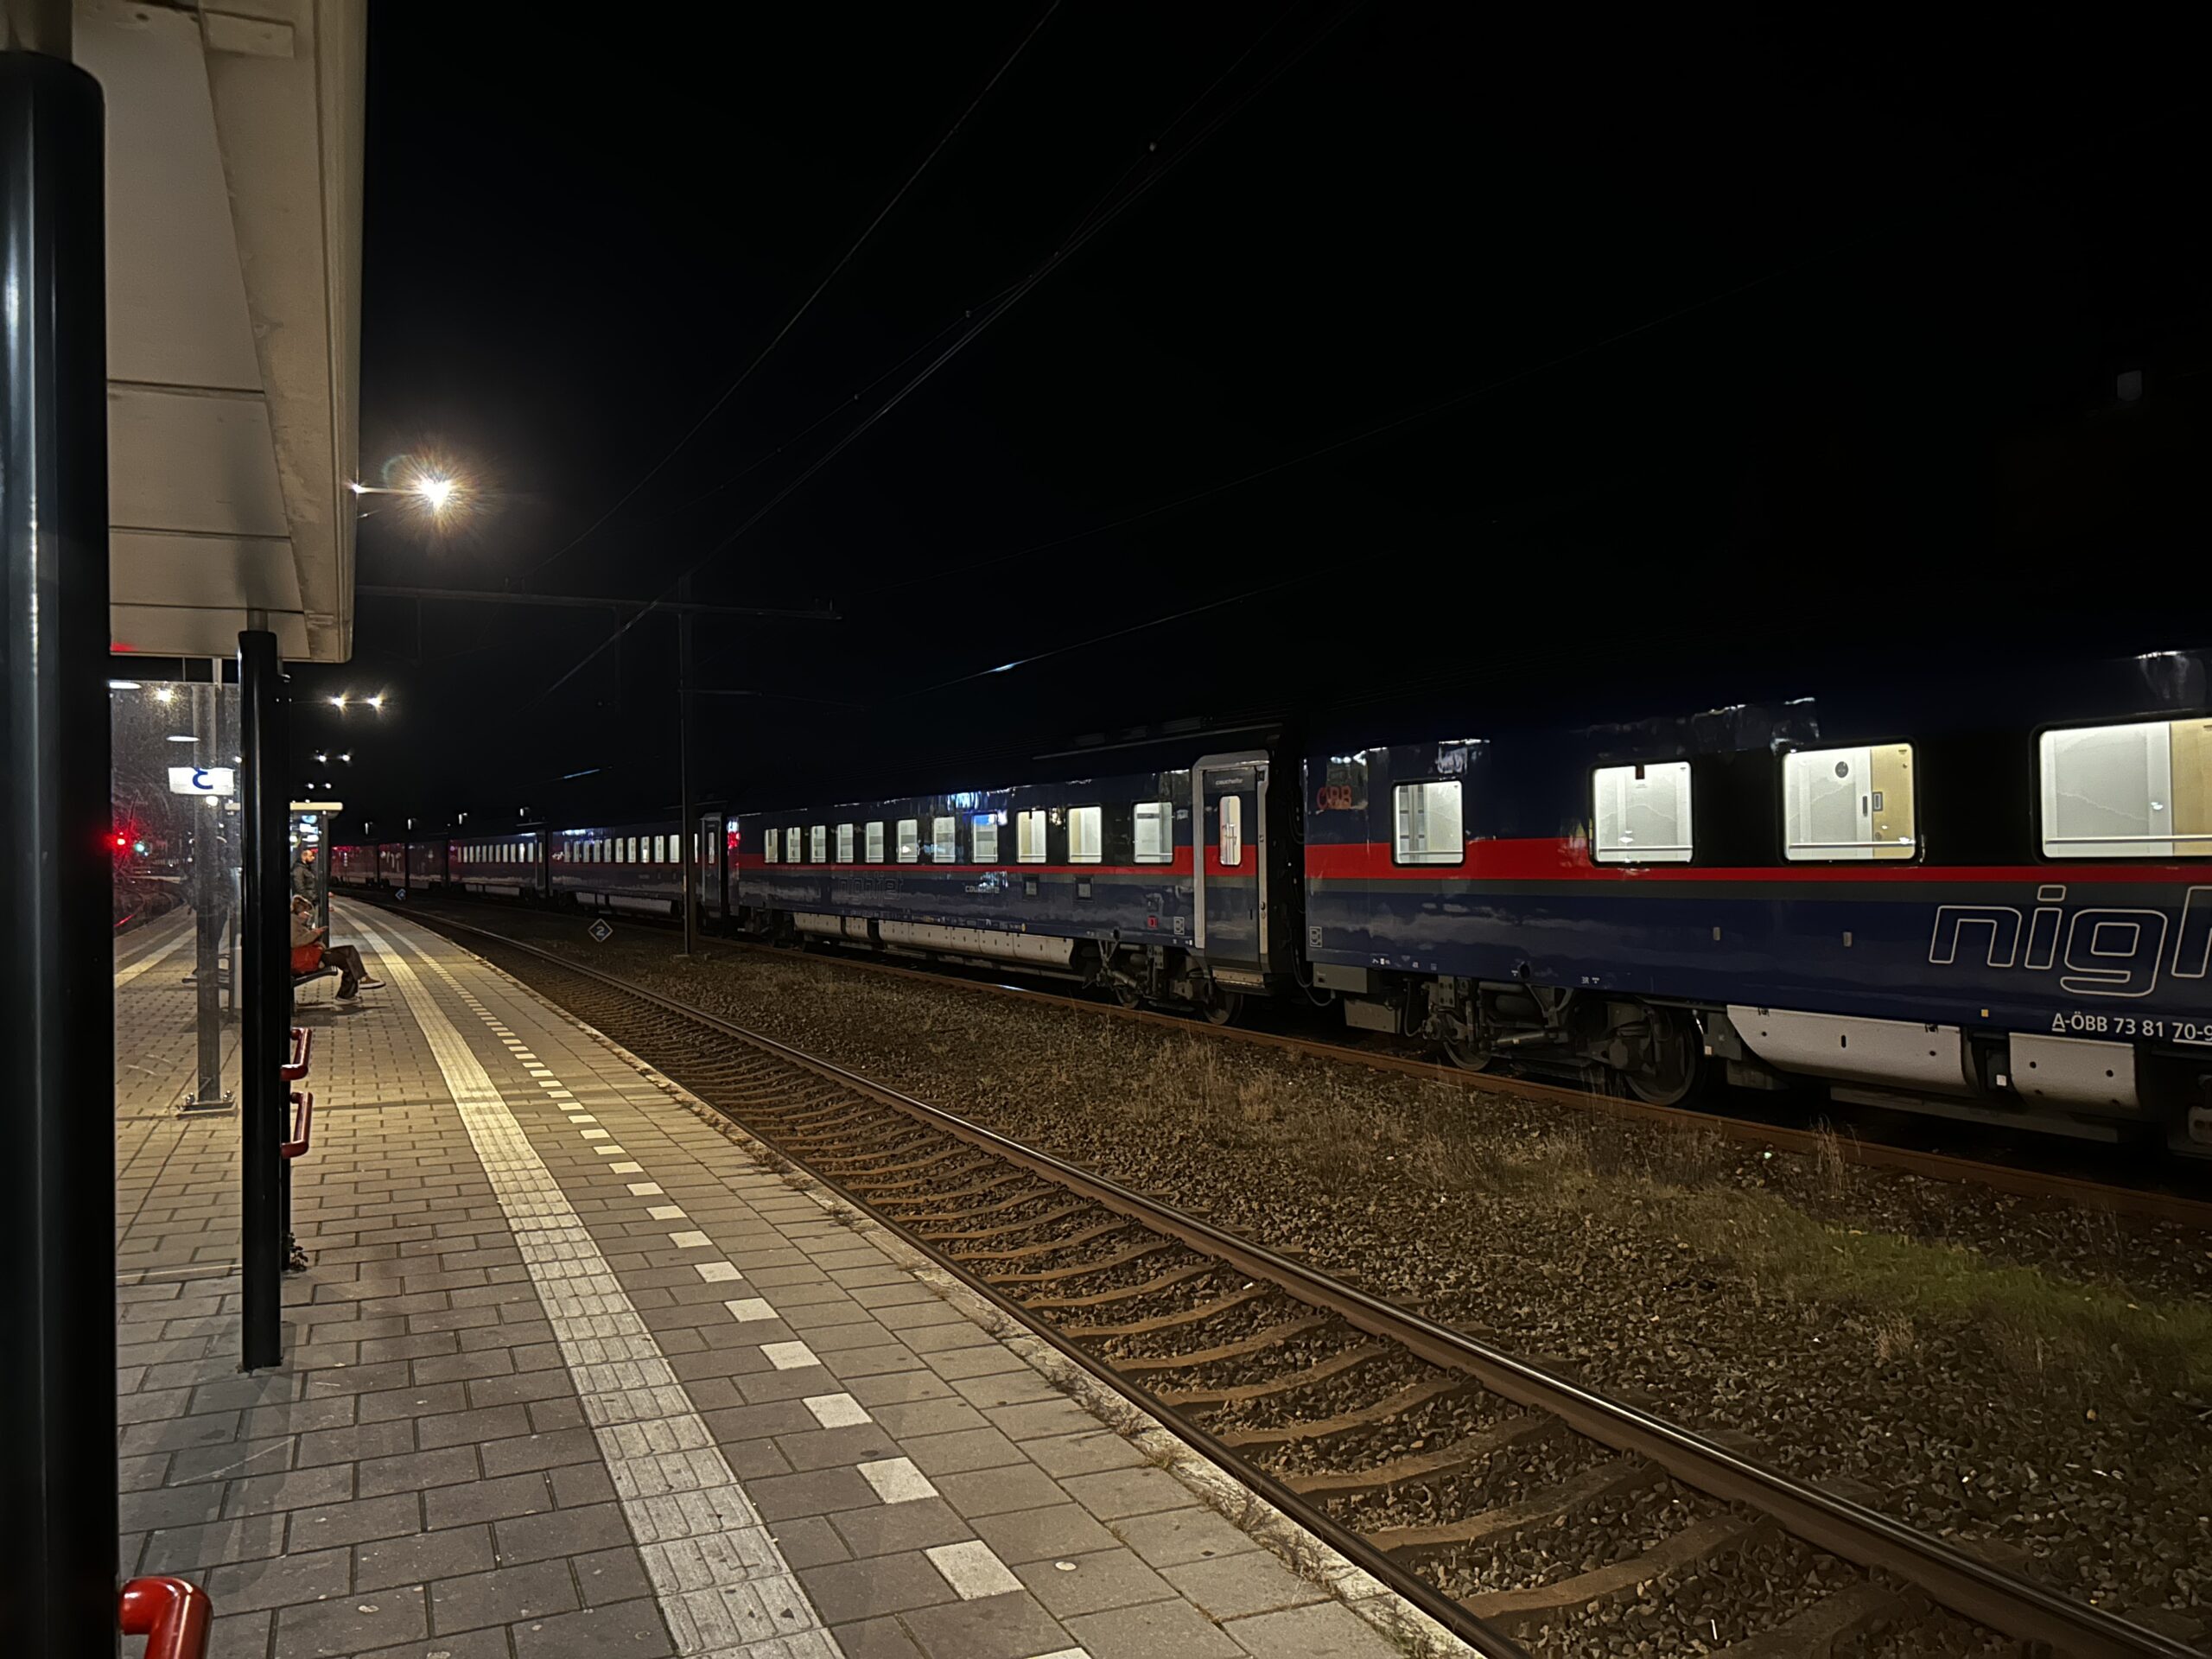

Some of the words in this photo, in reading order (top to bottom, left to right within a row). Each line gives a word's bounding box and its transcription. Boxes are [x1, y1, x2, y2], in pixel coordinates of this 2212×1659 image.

[595, 925, 606, 937] 2
[2051, 1011, 2108, 1033] A-ÖBB
[2113, 1017, 2136, 1035] 73
[2141, 1020, 2164, 1038] 81
